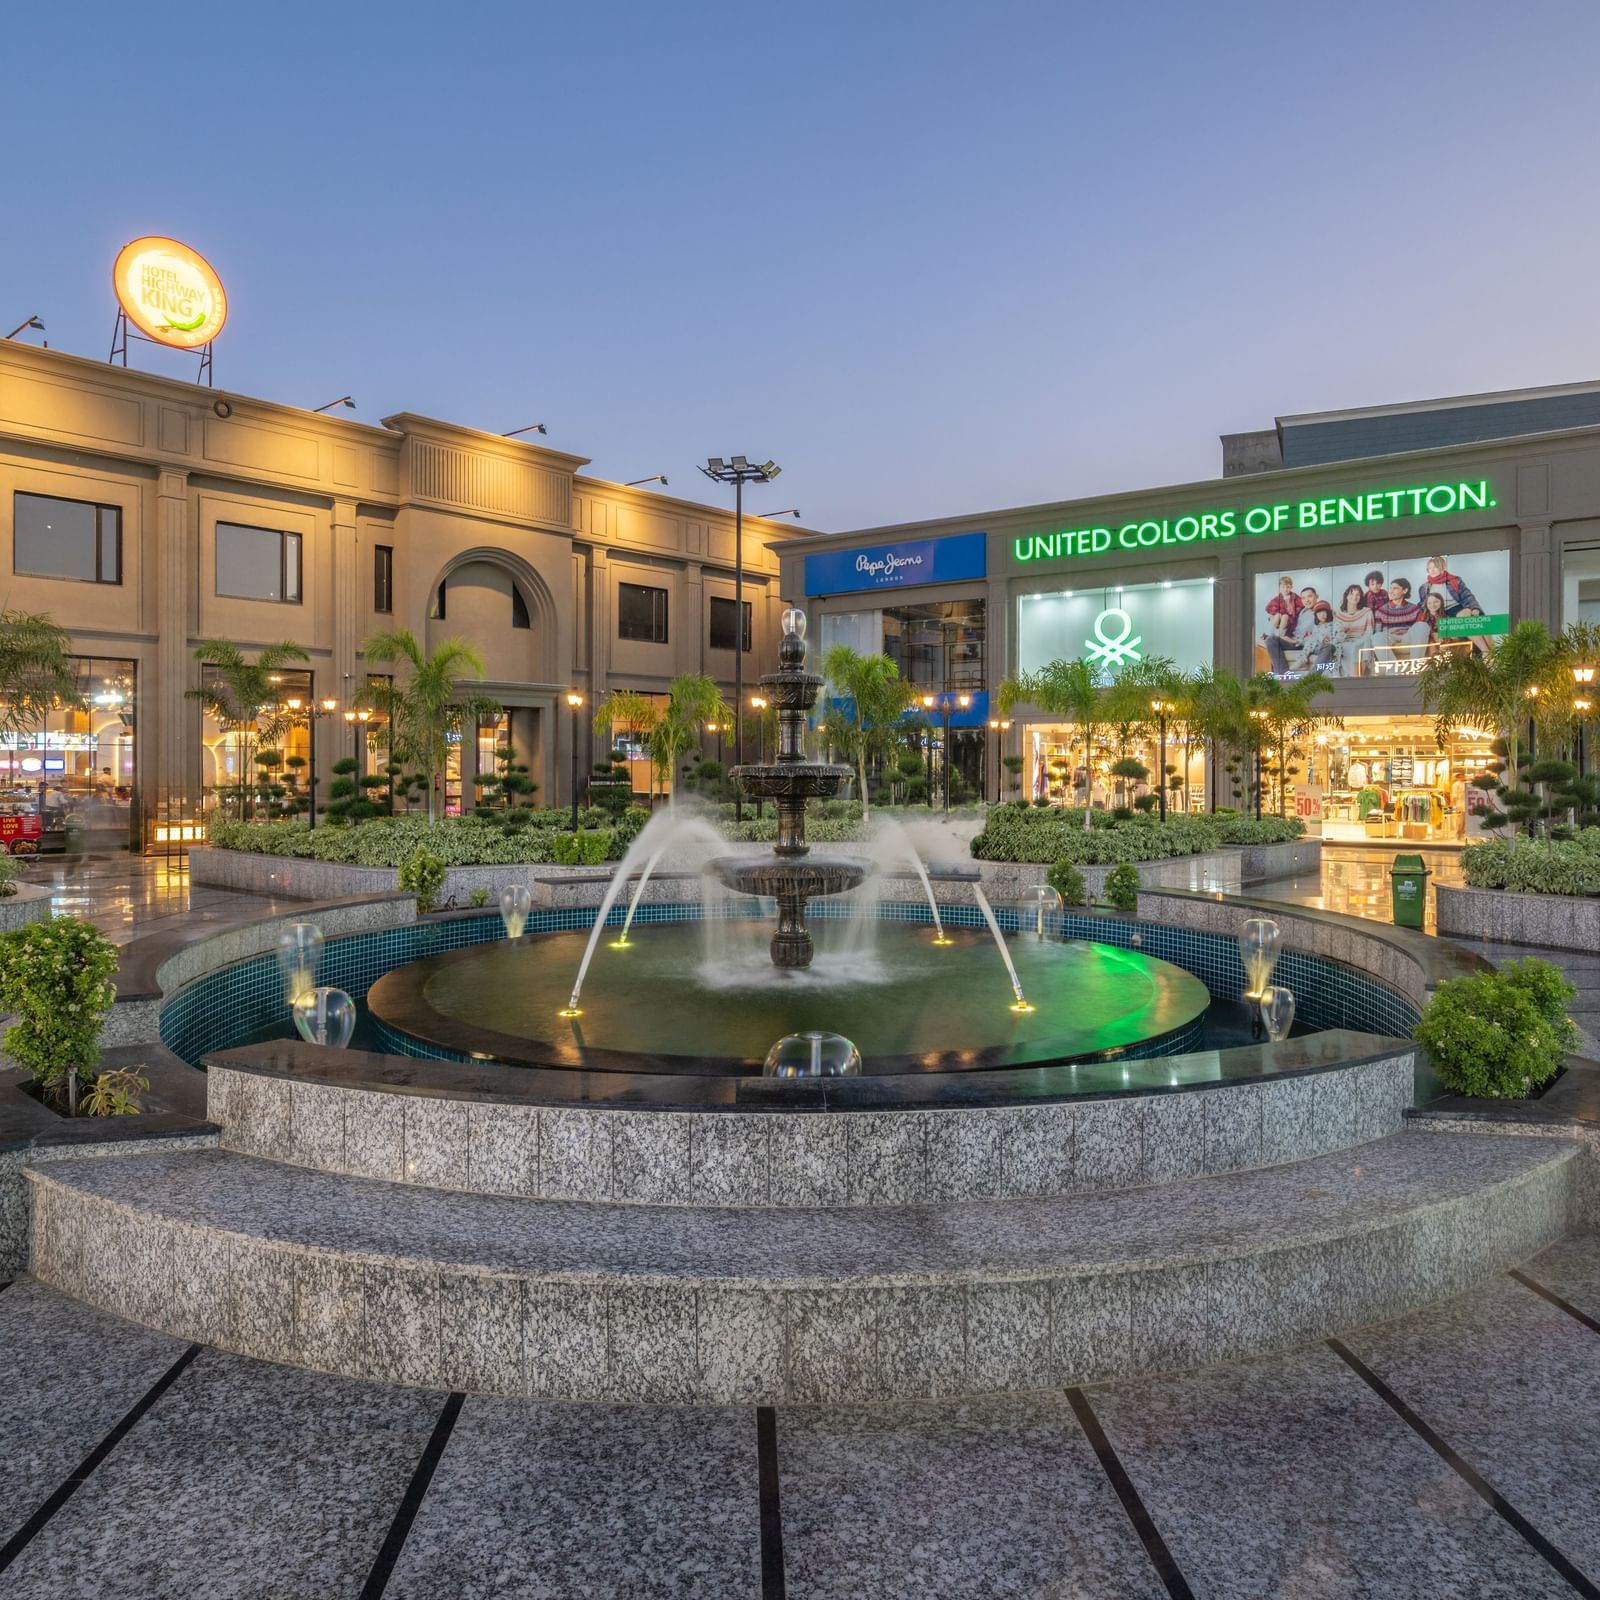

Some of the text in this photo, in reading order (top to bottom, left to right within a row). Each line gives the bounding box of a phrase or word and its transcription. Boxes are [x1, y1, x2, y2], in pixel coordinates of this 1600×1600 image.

[142, 263, 179, 282] HOTEL
[141, 275, 205, 302] HIGHWAY
[141, 286, 193, 317] KING
[1015, 480, 1497, 560] UNITED COLORS OF BENETTON.
[856, 553, 923, 576] Pepe Jeans
[1463, 616, 1491, 624] COLORS
